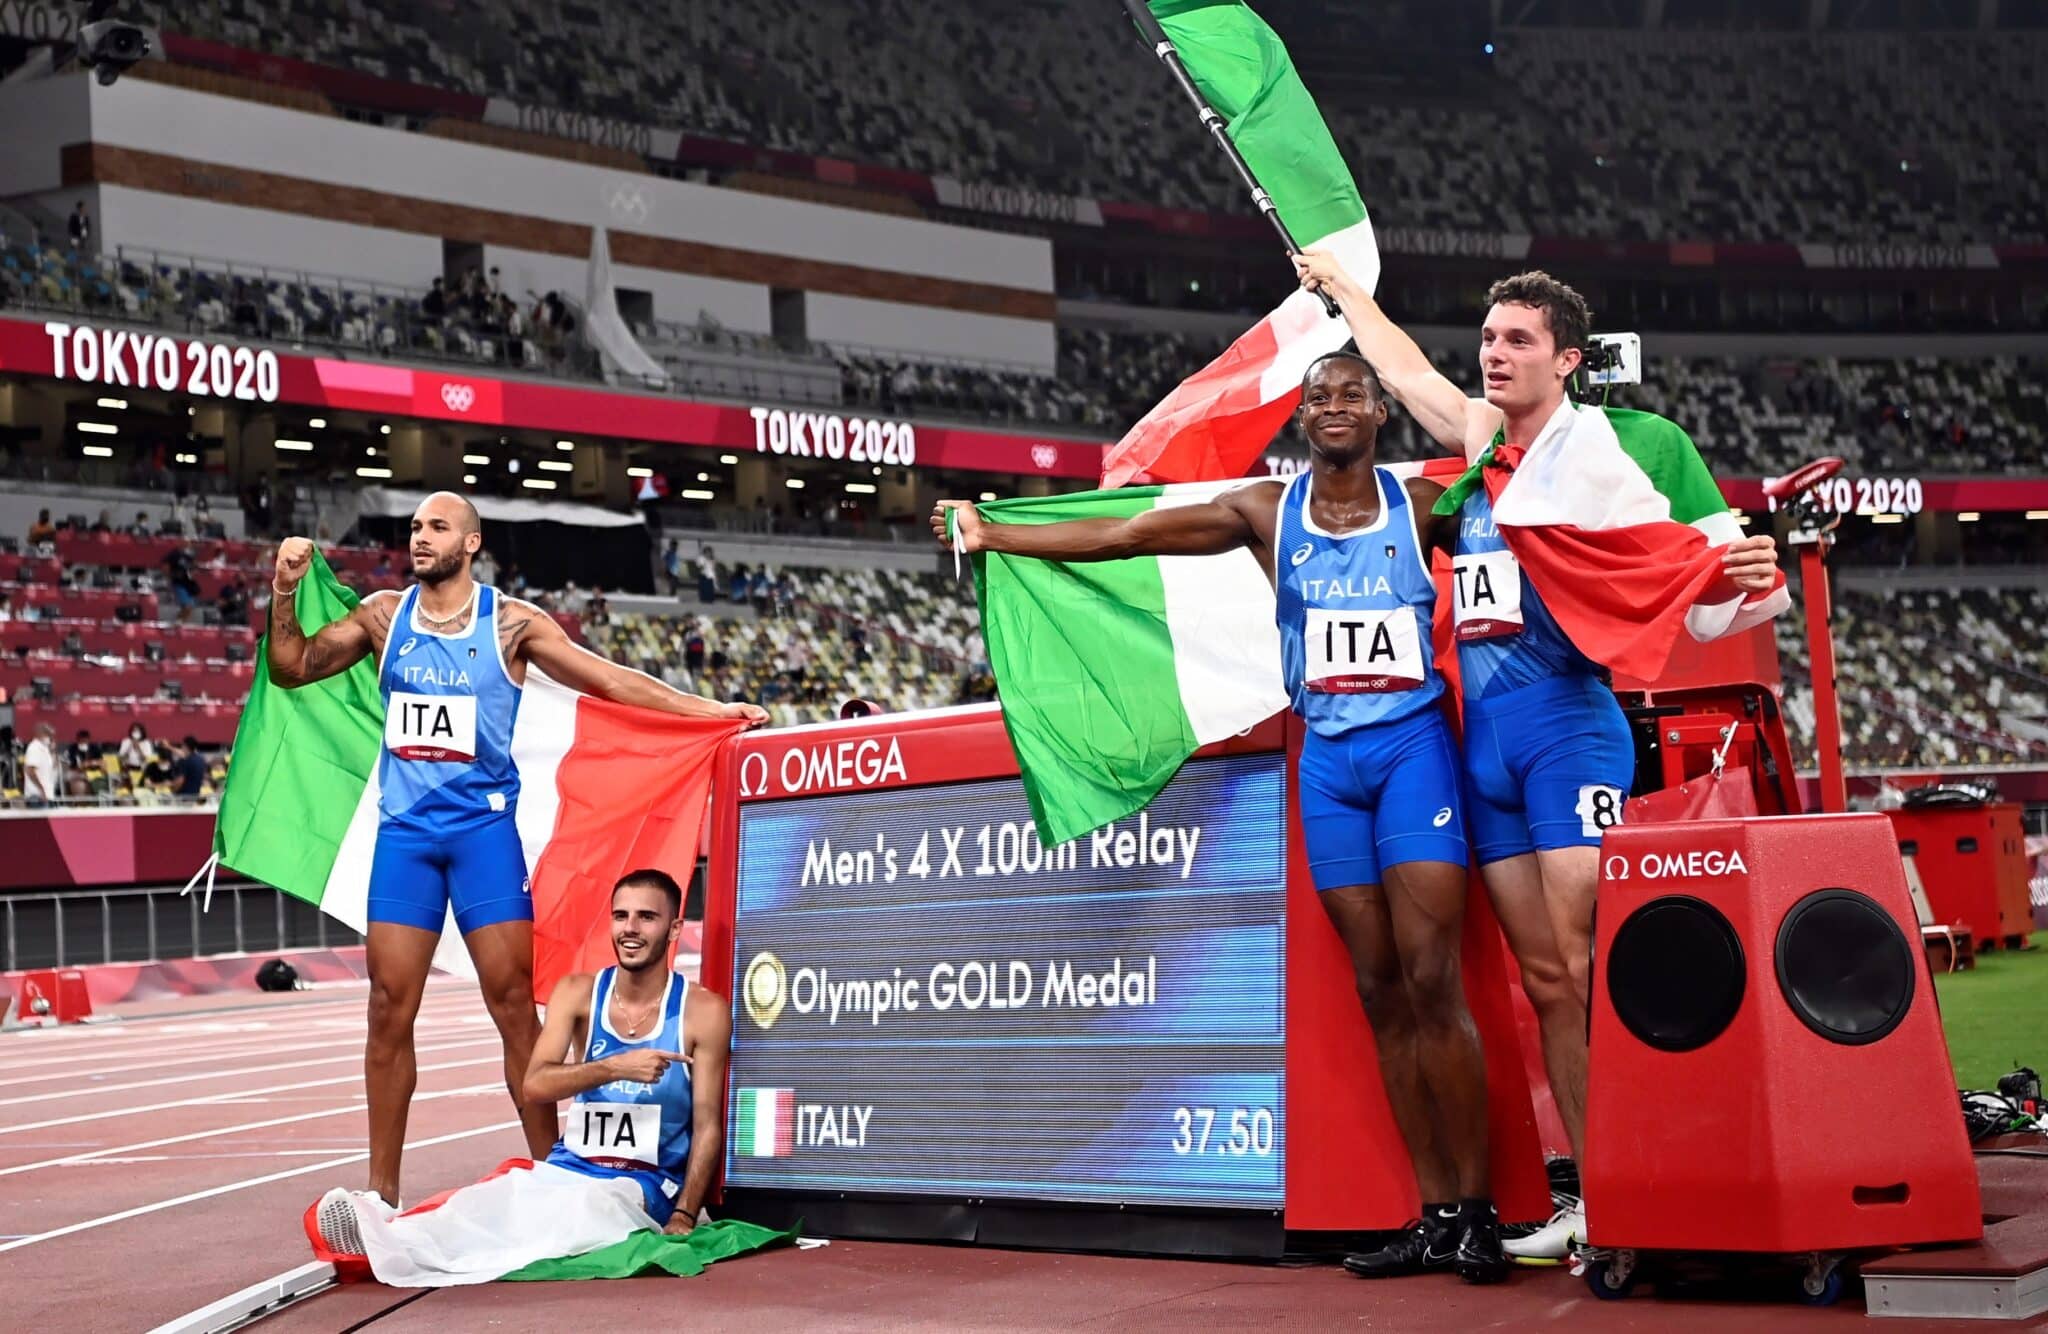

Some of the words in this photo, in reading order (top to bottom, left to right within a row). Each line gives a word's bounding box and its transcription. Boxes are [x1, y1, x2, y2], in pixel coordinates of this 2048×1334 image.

[45, 322, 180, 391] TOKYO
[187, 340, 280, 402] 2020
[750, 407, 845, 460] TOKYO
[848, 418, 916, 466] 2020
[1856, 478, 1923, 515] 2020
[1302, 576, 1392, 600] ITALIA
[1326, 621, 1396, 663] ITA
[404, 666, 471, 687] ITALIA
[403, 702, 454, 737] ITA
[781, 735, 908, 793] OMEGA
[1593, 790, 1616, 831] 8
[800, 832, 898, 887] Men's
[907, 830, 931, 879] 4
[939, 826, 965, 878] X
[975, 820, 1076, 876] 100m
[1091, 812, 1200, 879] Relay
[1640, 849, 1748, 880] OMEGA
[791, 966, 920, 1026] Olympic
[928, 961, 1033, 1011] GOLD
[1042, 955, 1156, 1008] Medal
[583, 1111, 636, 1148] ITA
[796, 1104, 873, 1147] ITALY
[1172, 1107, 1273, 1156] 37.50
